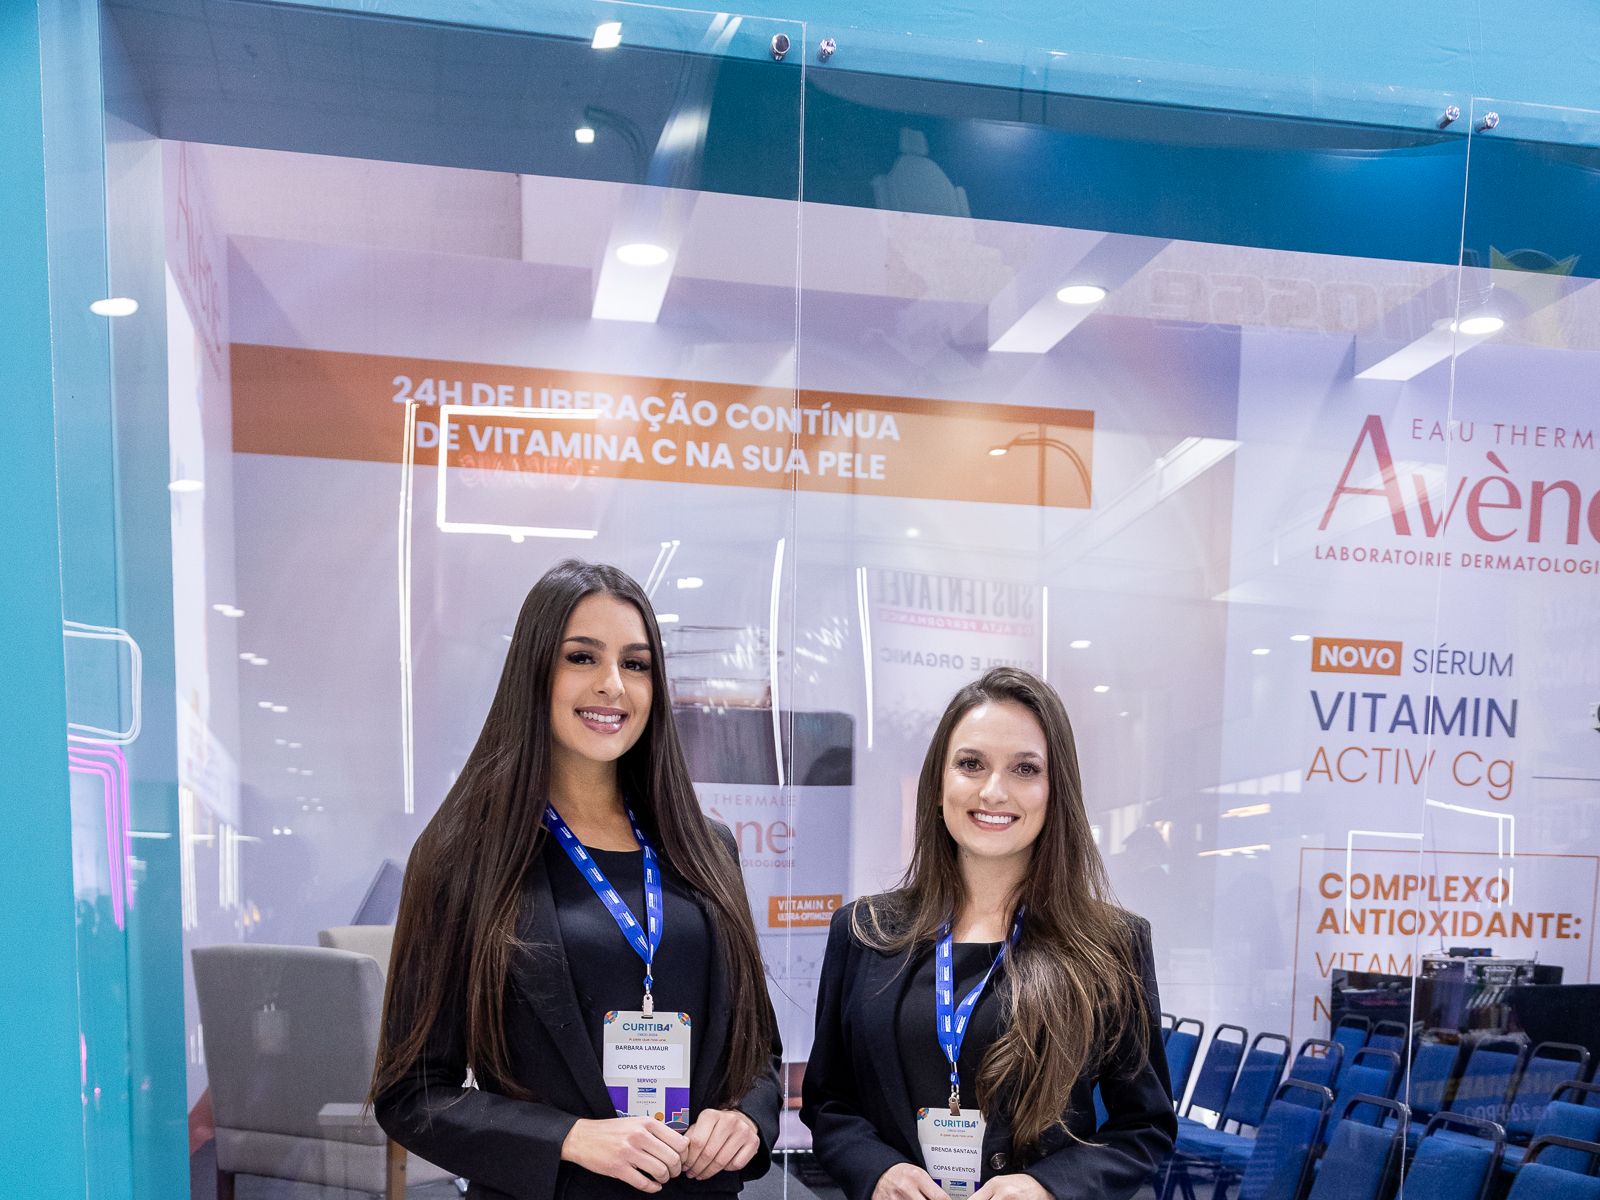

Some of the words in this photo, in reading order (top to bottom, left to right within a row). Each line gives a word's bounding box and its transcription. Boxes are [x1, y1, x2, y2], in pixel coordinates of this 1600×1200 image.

[392, 374, 463, 407] 24H
[471, 382, 515, 407] DE
[524, 386, 718, 433] LIBERAÇÃO
[725, 400, 900, 441] CONTÍNUA
[415, 420, 460, 451] DE
[467, 424, 645, 465] VITAMINA
[651, 437, 678, 466] C
[685, 440, 735, 471] NA
[742, 444, 811, 475] SUA
[817, 450, 887, 481] PELE
[1412, 418, 1474, 443] EAU
[1493, 423, 1600, 451] THERM
[1317, 414, 1600, 546] Avèn
[1318, 644, 1396, 670] NOVO
[1309, 689, 1519, 739] VITAMIN
[1305, 745, 1437, 785] ACTIV
[1452, 750, 1516, 801] Cg
[1318, 872, 1511, 904] COMPLEXO
[1315, 907, 1583, 940] ANTIOXIDANTE:
[933, 1164, 951, 1172] COPAS
[951, 1165, 976, 1174] EVENTOS
